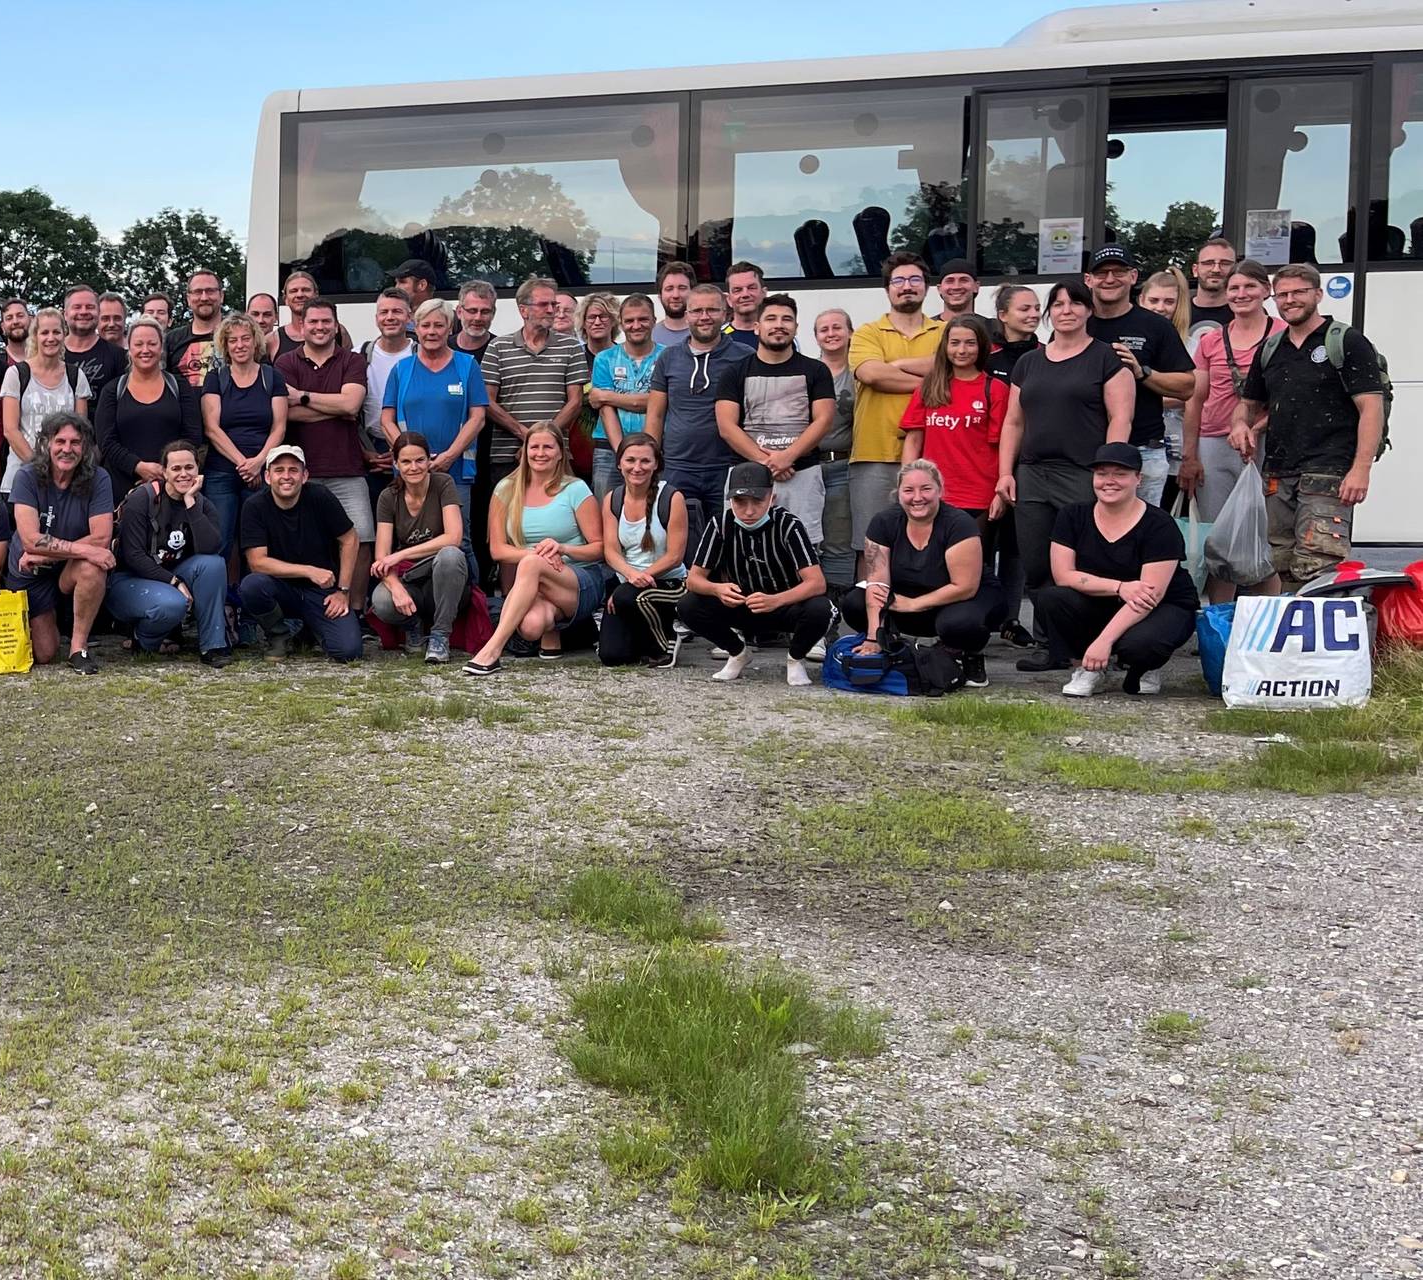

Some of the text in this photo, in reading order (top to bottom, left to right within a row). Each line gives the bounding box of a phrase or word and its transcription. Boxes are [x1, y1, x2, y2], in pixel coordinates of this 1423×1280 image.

[926, 412, 960, 430] afety
[1270, 600, 1360, 652] AC
[1256, 680, 1340, 697] ACTION
